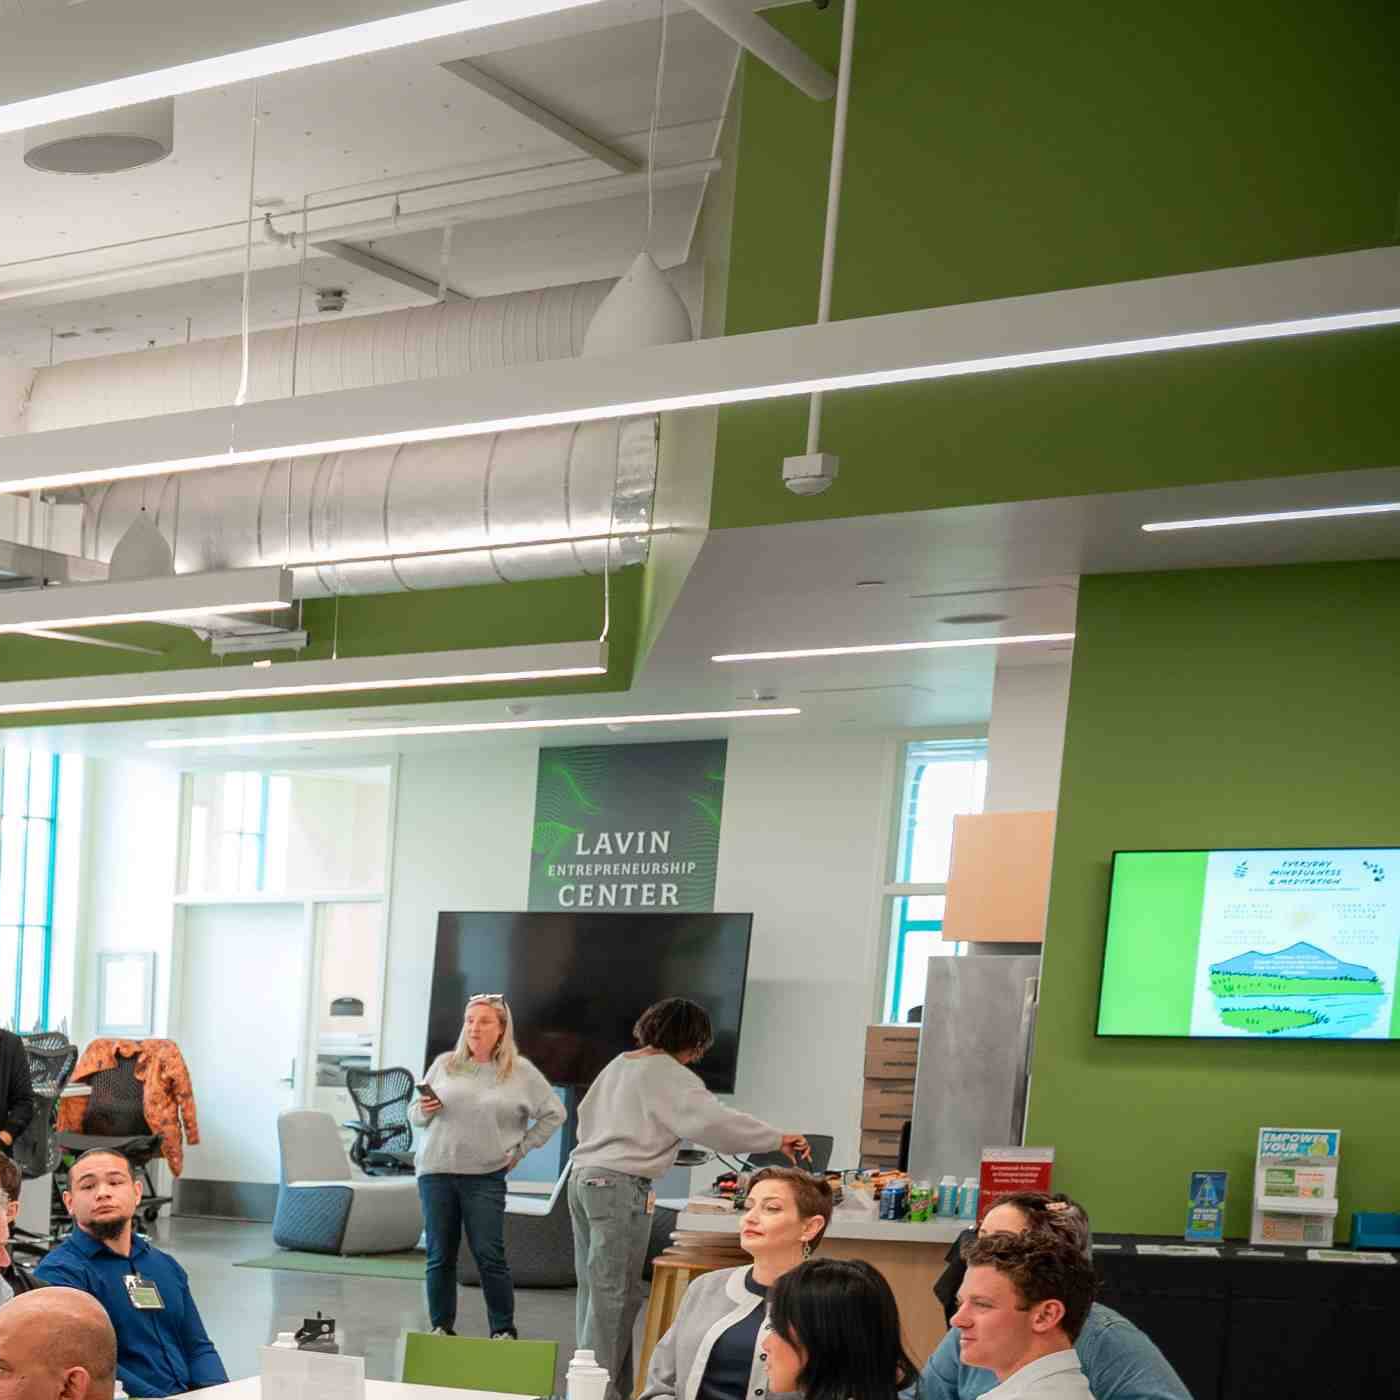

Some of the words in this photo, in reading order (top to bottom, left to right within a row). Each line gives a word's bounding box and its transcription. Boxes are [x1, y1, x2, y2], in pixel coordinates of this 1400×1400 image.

[575, 830, 670, 856] LAVIN
[1281, 860, 1333, 868] EVERYDAY
[548, 861, 697, 877] ENTREPRENEURSHIP
[1269, 868, 1342, 876] MINDFULNESS
[1277, 877, 1343, 885] MEDITATION
[558, 883, 680, 907] CENTER
[1263, 1133, 1329, 1143] EMPOWER
[1263, 1142, 1298, 1151] YOUR
